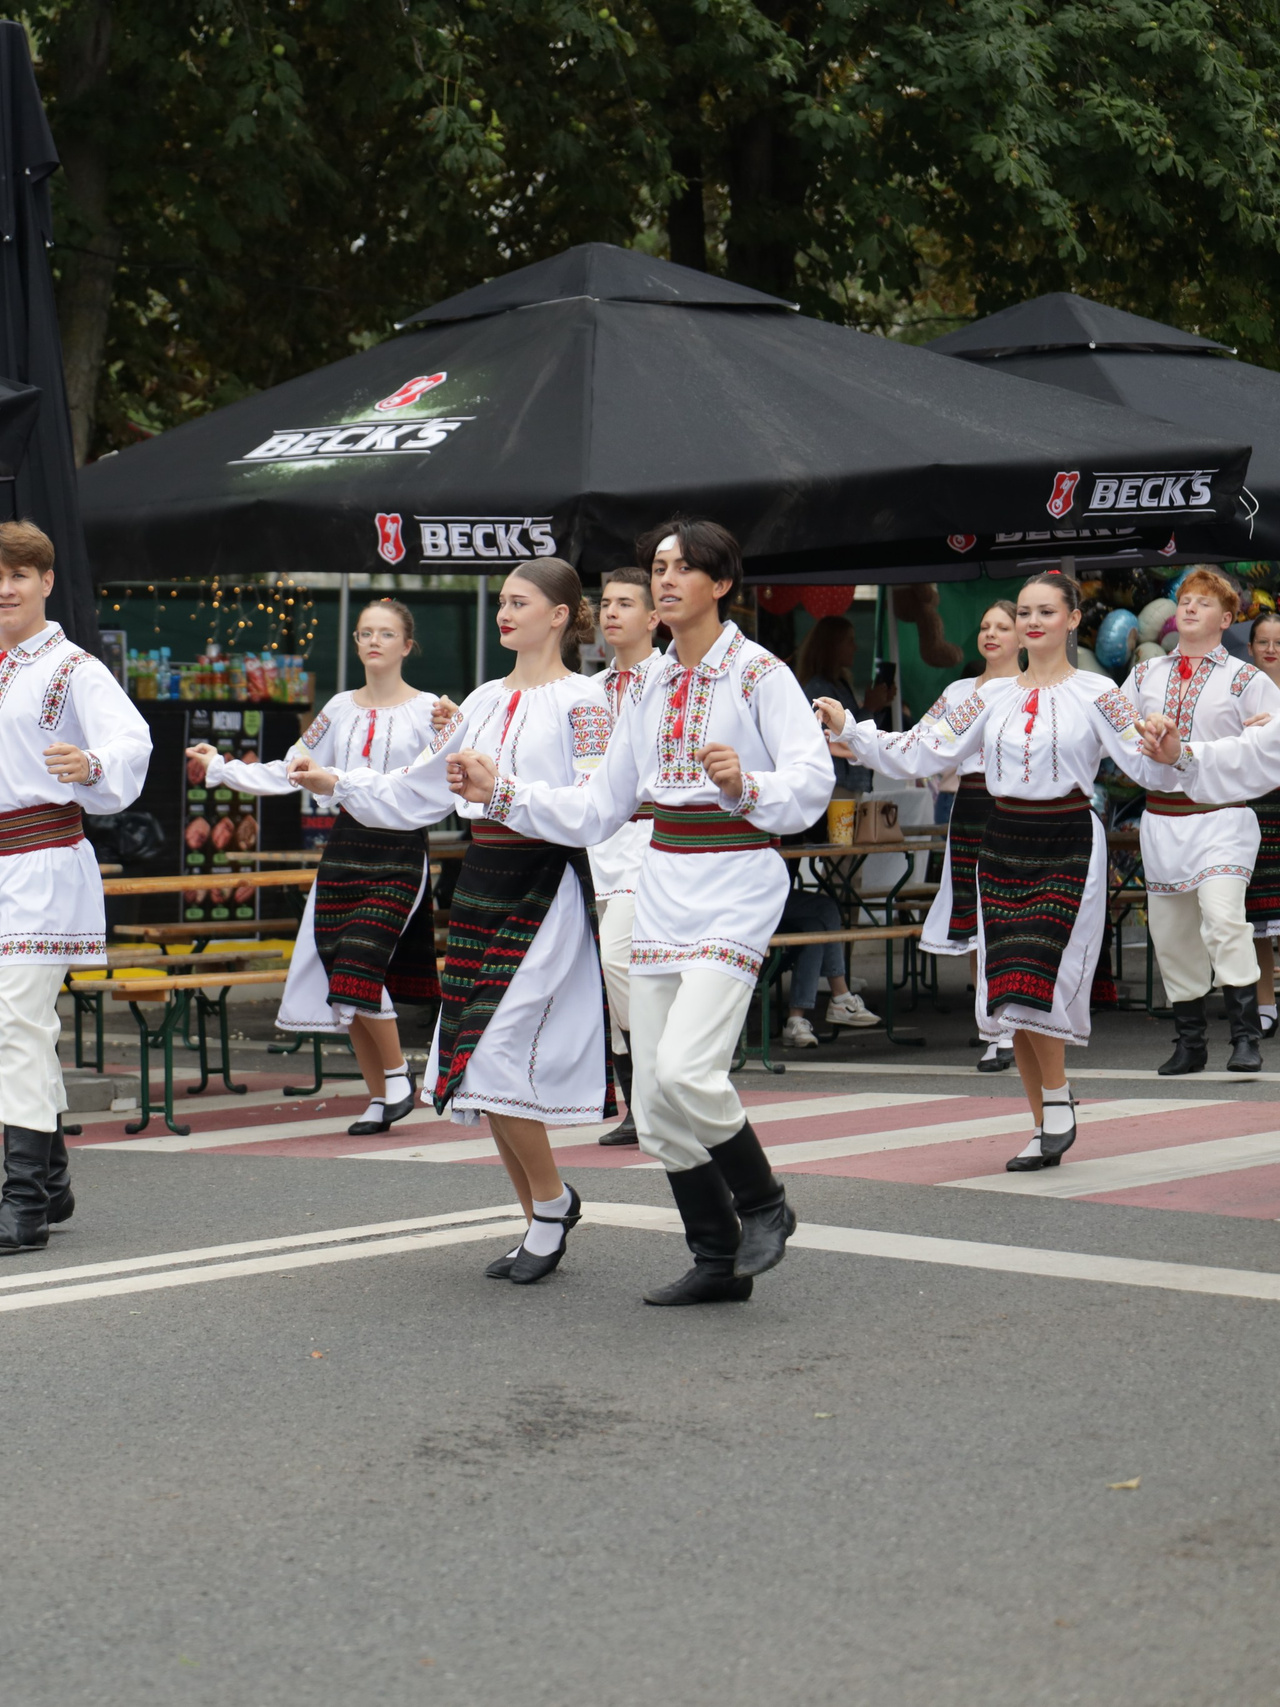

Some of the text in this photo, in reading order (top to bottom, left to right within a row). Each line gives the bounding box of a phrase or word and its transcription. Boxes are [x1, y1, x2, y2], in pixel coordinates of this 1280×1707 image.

[242, 417, 462, 460] BECK'S
[1088, 471, 1212, 510] BECK'S
[419, 517, 557, 558] BECK'S
